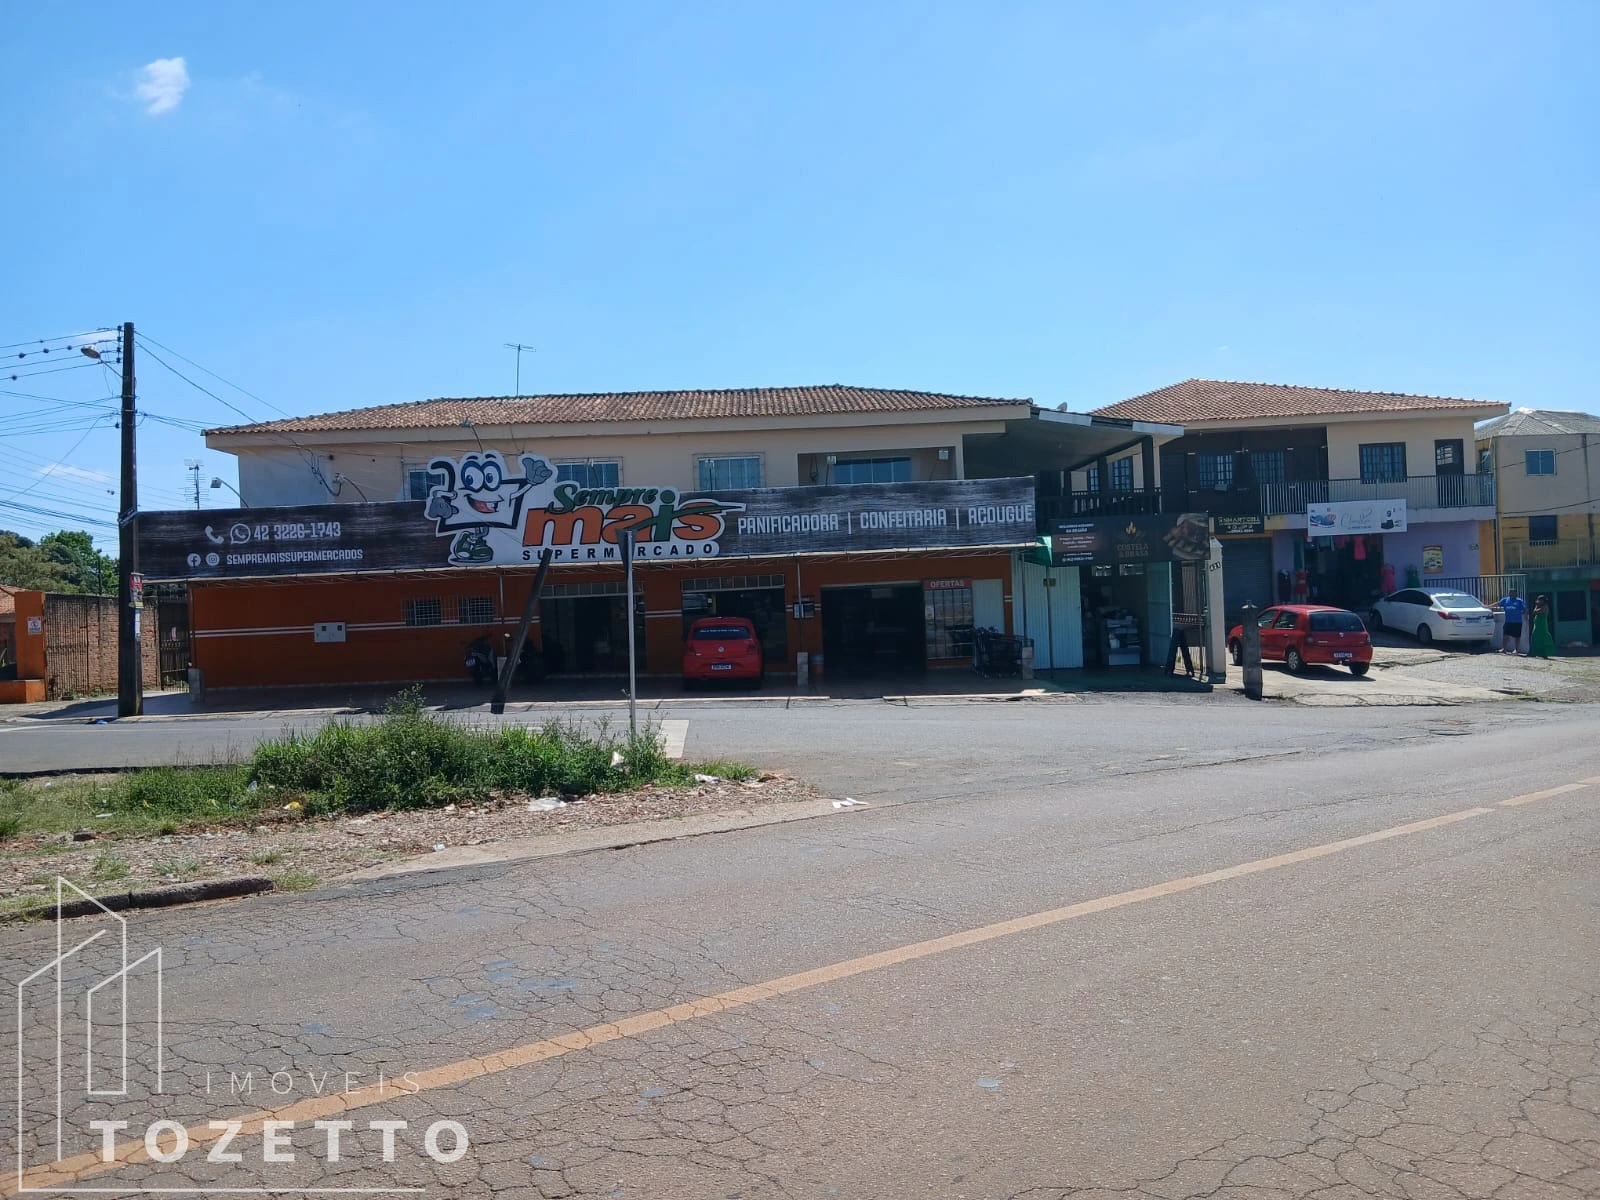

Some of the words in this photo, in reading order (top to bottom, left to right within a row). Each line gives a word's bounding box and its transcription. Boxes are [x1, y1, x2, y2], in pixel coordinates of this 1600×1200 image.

[544, 483, 659, 513] Sempre
[522, 489, 746, 547] mais
[738, 514, 839, 534] PANIFICADORA
[860, 508, 947, 529] CONFEITARIA
[968, 504, 1033, 527] AÇOUGUE
[253, 525, 269, 540] 42
[274, 522, 341, 539] 3226-1743
[226, 549, 363, 565] SEMPREMAISSUPERMERCADOS
[522, 543, 713, 561] SUPERMRCADO
[930, 579, 965, 588] OFERTAS
